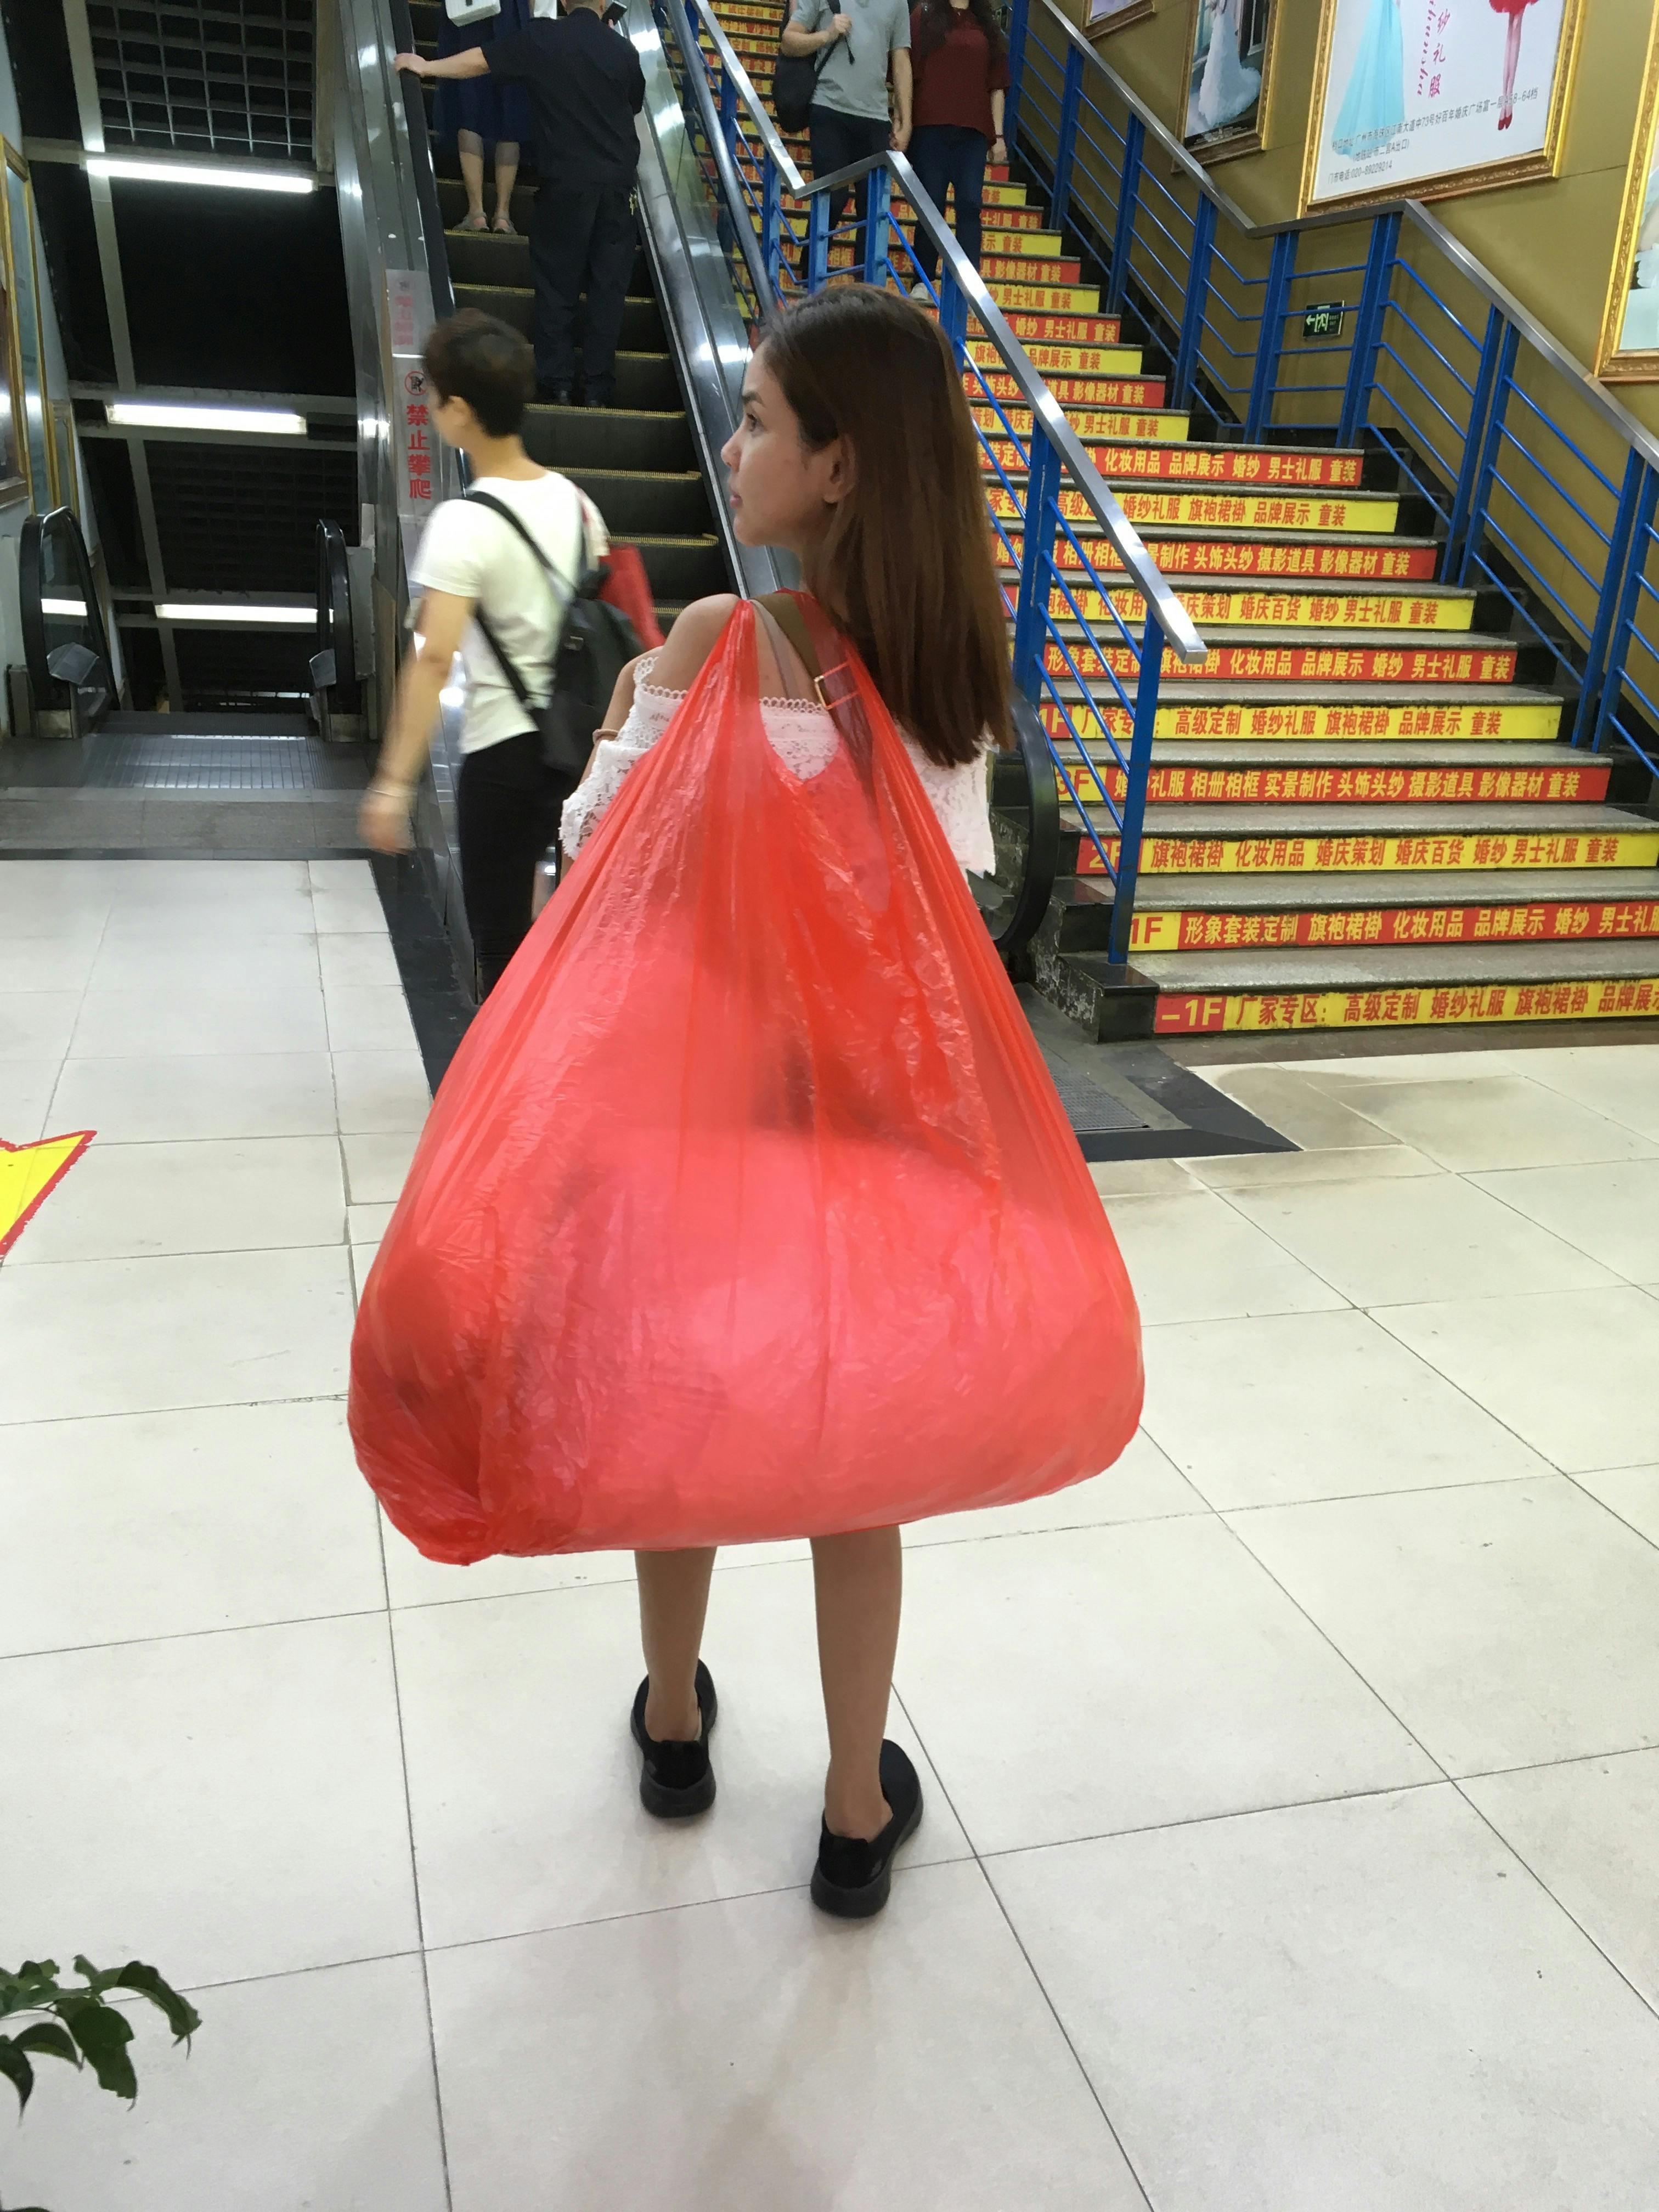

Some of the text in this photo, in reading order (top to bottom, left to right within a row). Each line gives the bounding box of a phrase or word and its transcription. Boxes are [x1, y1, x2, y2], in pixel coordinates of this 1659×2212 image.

[1003, 235, 1023, 252] 童装
[1041, 264, 1061, 282] 童装
[1002, 288, 1045, 307] 男士礼服
[1051, 291, 1071, 309] 童装
[1015, 317, 1116, 342] 婚纱 男士礼服 童装
[1029, 348, 1072, 368] 品牌展示
[1079, 352, 1101, 370] 童装
[1074, 381, 1119, 403] 影像器材
[1122, 386, 1145, 404] 童装
[1084, 415, 1129, 436] 男士礼服
[1136, 419, 1159, 437] 童装
[407, 404, 432, 500] 禁止攀爬
[1104, 448, 1160, 473] 化妆用品
[1169, 452, 1224, 477] 品牌展示
[1232, 454, 1260, 478] 婚纱
[1268, 457, 1322, 481] 男士礼服
[1329, 459, 1357, 482] 童装
[1123, 494, 1180, 520] 婚纱礼服
[1188, 498, 1246, 523] 旗袍裙褂
[1254, 501, 1310, 525] 品牌展示
[1318, 504, 1346, 527] 童装
[1194, 546, 1254, 571] 头饰头纱
[1259, 547, 1315, 573] 摄影道具
[1321, 549, 1378, 574] 影像器材
[1381, 552, 1410, 575] 童装
[1099, 592, 1144, 617] 化妆用
[1240, 597, 1301, 622] 婚庆百货
[1309, 598, 1339, 622] 婚纱
[1344, 600, 1402, 623] 男士礼服
[1408, 601, 1438, 625] 童装
[1230, 650, 1293, 676] 化妆用品
[1301, 651, 1364, 678] 品牌展示
[1372, 652, 1403, 678] 婚纱
[1410, 653, 1472, 679] 男士礼服
[1479, 656, 1511, 680] 童装
[1175, 708, 1242, 736] 高级定制
[1250, 709, 1316, 736] 婚纱礼服
[1324, 710, 1389, 736] 旗袍裙褂
[1398, 710, 1462, 736] 品牌展示
[1470, 710, 1502, 736] 童装
[1114, 770, 1184, 798] 婚礼服
[1190, 770, 1261, 798] 相册相框
[1264, 770, 1334, 798] 实景制作
[1337, 771, 1404, 798] 头饰头纱
[1408, 771, 1475, 798] 摄影道具
[1477, 771, 1544, 798] 影像器材
[1547, 772, 1581, 798] 童装
[1150, 840, 1224, 868] 旗袍裙褂
[1235, 839, 1305, 867] 化妆用品
[1316, 838, 1386, 866] 婚庆策划
[1395, 838, 1465, 865] 婚庆百货
[1472, 839, 1508, 865] 婚纱
[1511, 838, 1579, 864] 男士礼服
[1585, 837, 1619, 862] 童装
[1131, 917, 1164, 944] 1F
[1184, 913, 1299, 945] 形象套装定制
[1307, 911, 1383, 941] 旗袍裙褂
[1393, 910, 1464, 939] 化妆用品
[1474, 908, 1546, 938] 品牌展示
[1554, 906, 1590, 935] 婚纱
[1344, 991, 1421, 1023] 高级定制
[1430, 989, 1506, 1019] 婚纱礼服
[1514, 985, 1590, 1017] 旗袍裙褂
